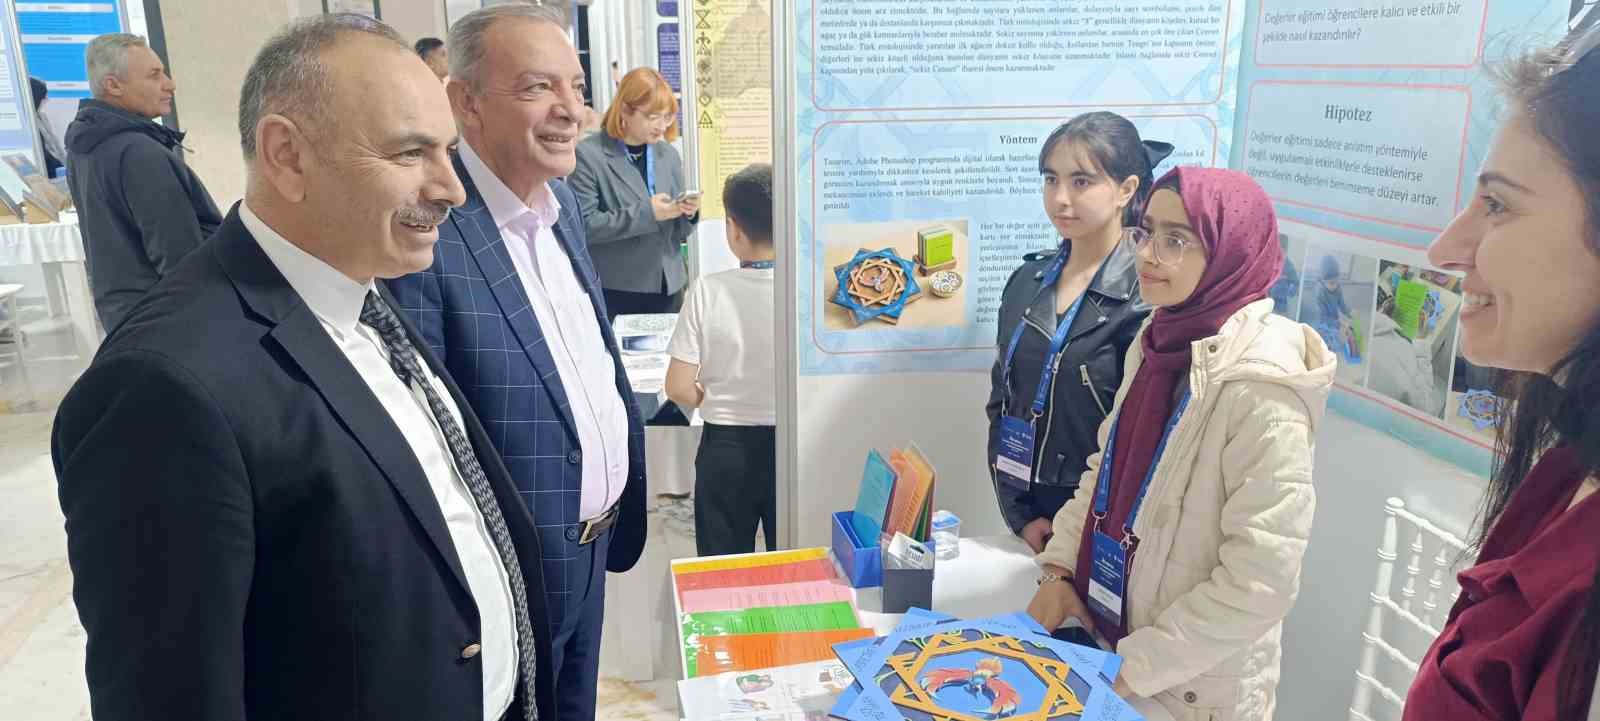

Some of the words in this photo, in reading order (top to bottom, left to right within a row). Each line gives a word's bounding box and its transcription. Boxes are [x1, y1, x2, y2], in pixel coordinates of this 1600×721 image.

[1380, 6, 1404, 18] kalıcı
[1406, 8, 1419, 17] ve
[1420, 5, 1445, 17] etkili
[1447, 3, 1461, 16] bir
[1324, 104, 1373, 124] Hipotez
[999, 135, 1038, 146] Yöntem
[1375, 143, 1428, 162] yöntemiyle
[1362, 163, 1423, 182] desteklenirse
[1376, 183, 1409, 203] düzeyi
[1410, 191, 1440, 207] artar.
